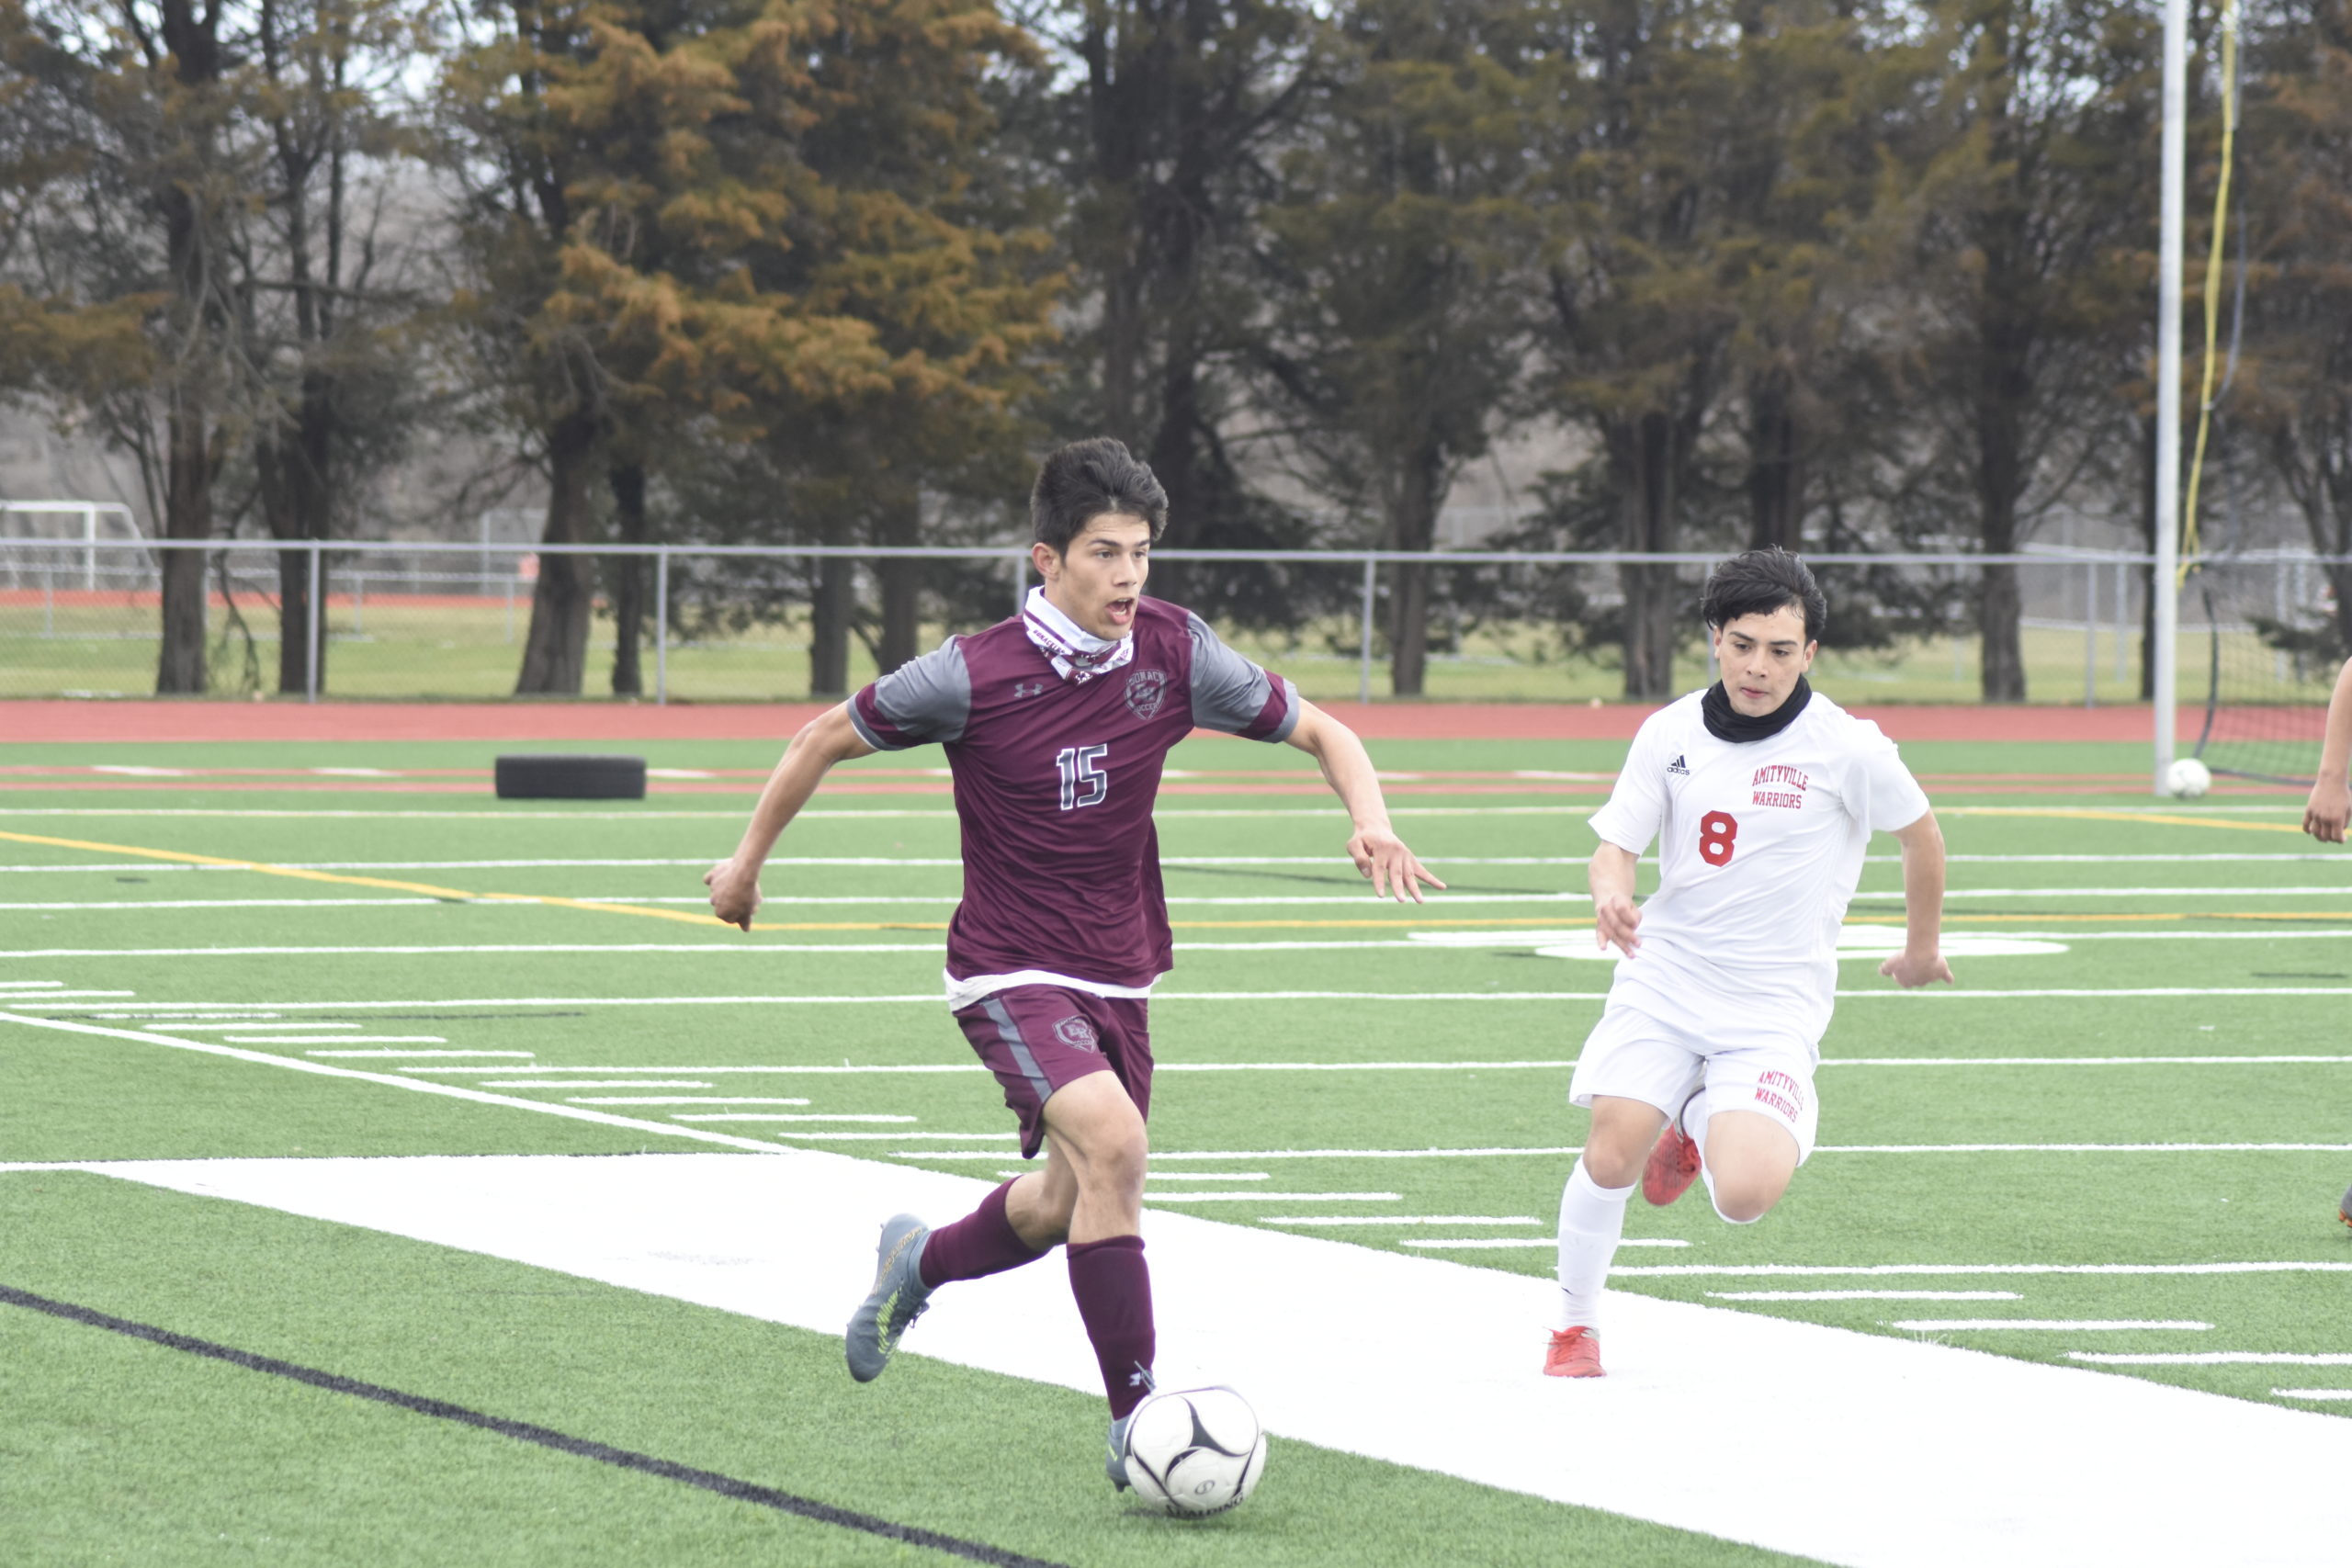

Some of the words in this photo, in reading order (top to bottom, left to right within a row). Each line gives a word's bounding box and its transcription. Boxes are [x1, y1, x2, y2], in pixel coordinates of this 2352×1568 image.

[1056, 743, 1108, 811] 15
[1667, 765, 1690, 776] adidas
[1752, 764, 1809, 792] AMITYVILLE
[1752, 791, 1803, 809] WARRIORS
[1699, 809, 1738, 868] 8
[1755, 1088, 1798, 1122] WARRIORS
